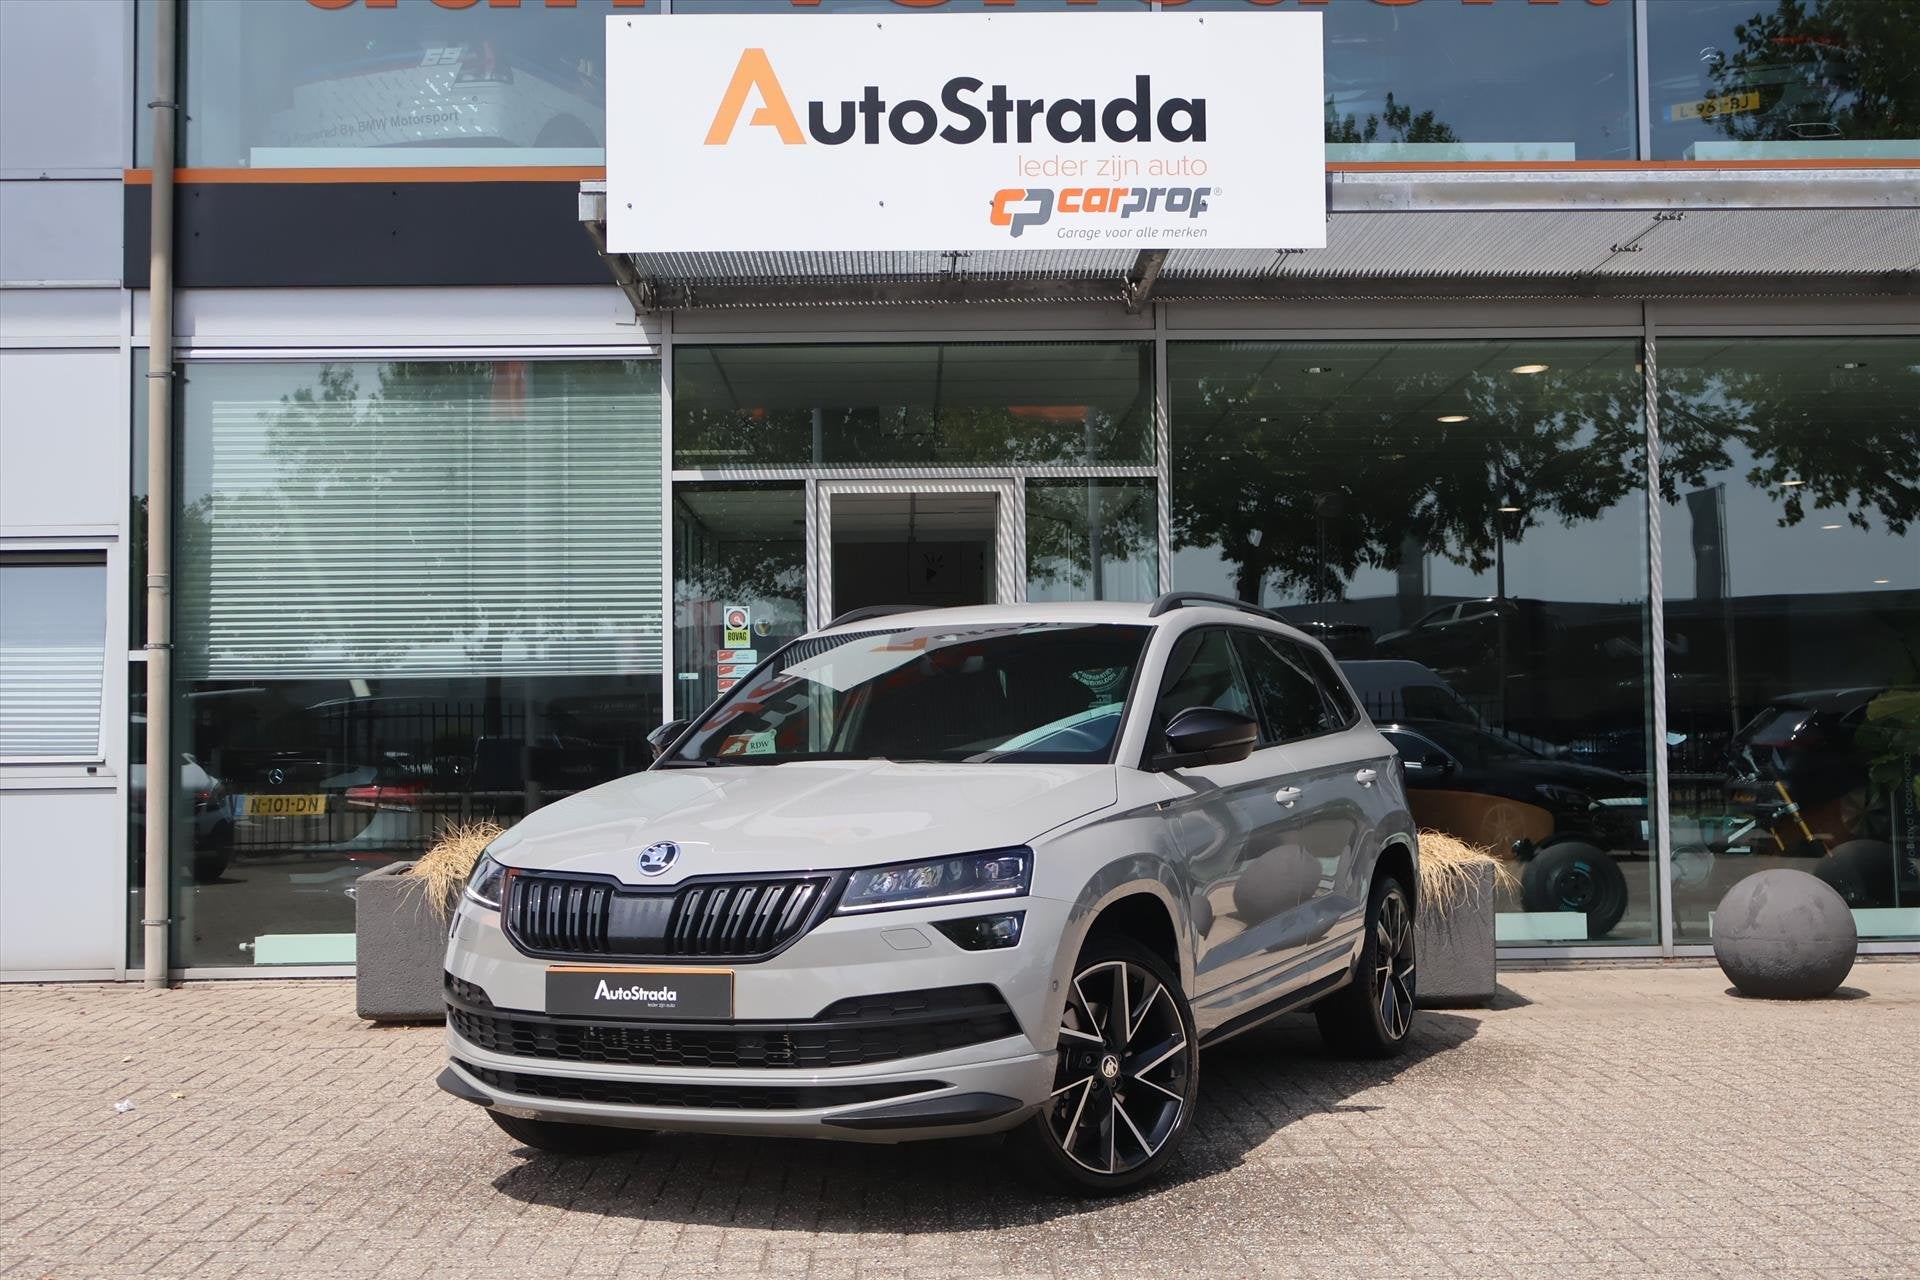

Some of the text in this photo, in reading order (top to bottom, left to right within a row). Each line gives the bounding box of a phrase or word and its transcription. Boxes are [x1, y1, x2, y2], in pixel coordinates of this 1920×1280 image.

[421, 48, 462, 66] 69
[704, 47, 1207, 146] AutoStrada
[358, 118, 387, 133] BMW
[390, 110, 459, 129] Motorsport
[1018, 155, 1208, 182] Ieder zijn auto
[1057, 226, 1208, 240] Garage voor alle merken
[727, 632, 747, 641] BOVAG
[750, 741, 768, 749] RDW
[250, 798, 319, 813] N-101-DN
[594, 979, 677, 1002] AutoStrada
